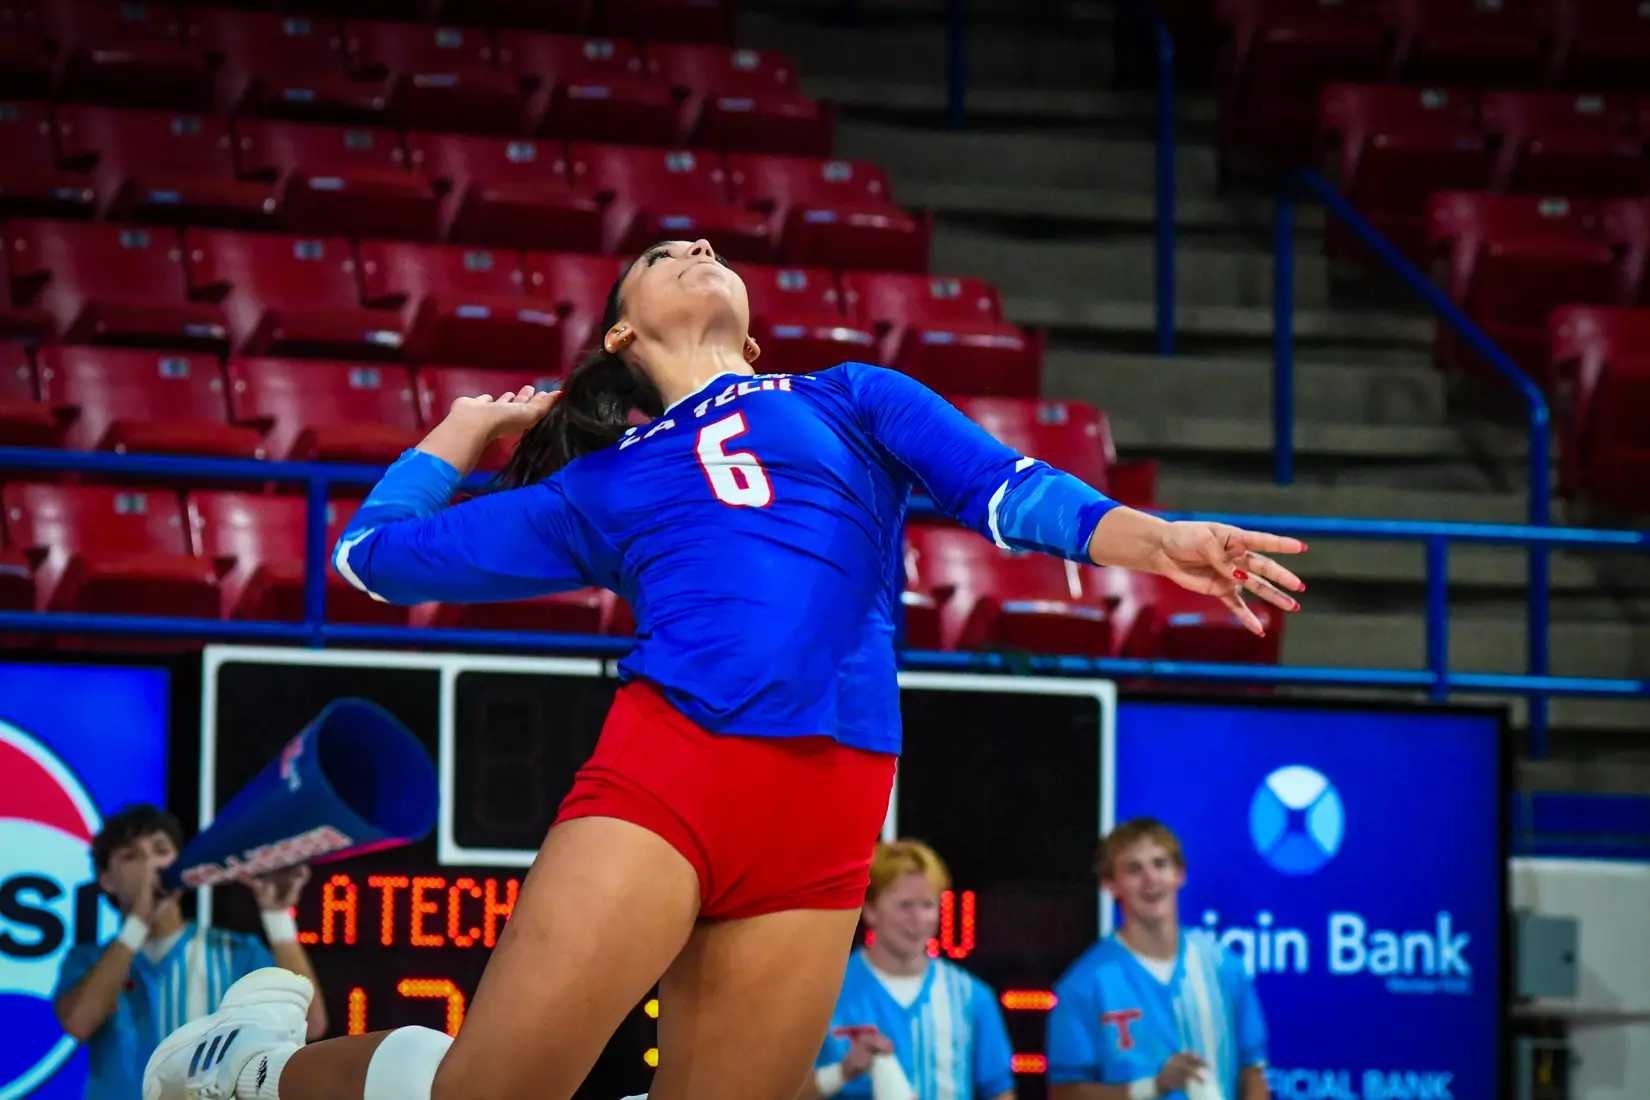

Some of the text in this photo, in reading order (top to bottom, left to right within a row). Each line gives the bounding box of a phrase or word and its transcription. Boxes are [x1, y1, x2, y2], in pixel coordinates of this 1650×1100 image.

[693, 378, 792, 418] TECH
[693, 409, 775, 508] 6
[367, 874, 519, 948] TECH
[1329, 911, 1470, 975] Bank
